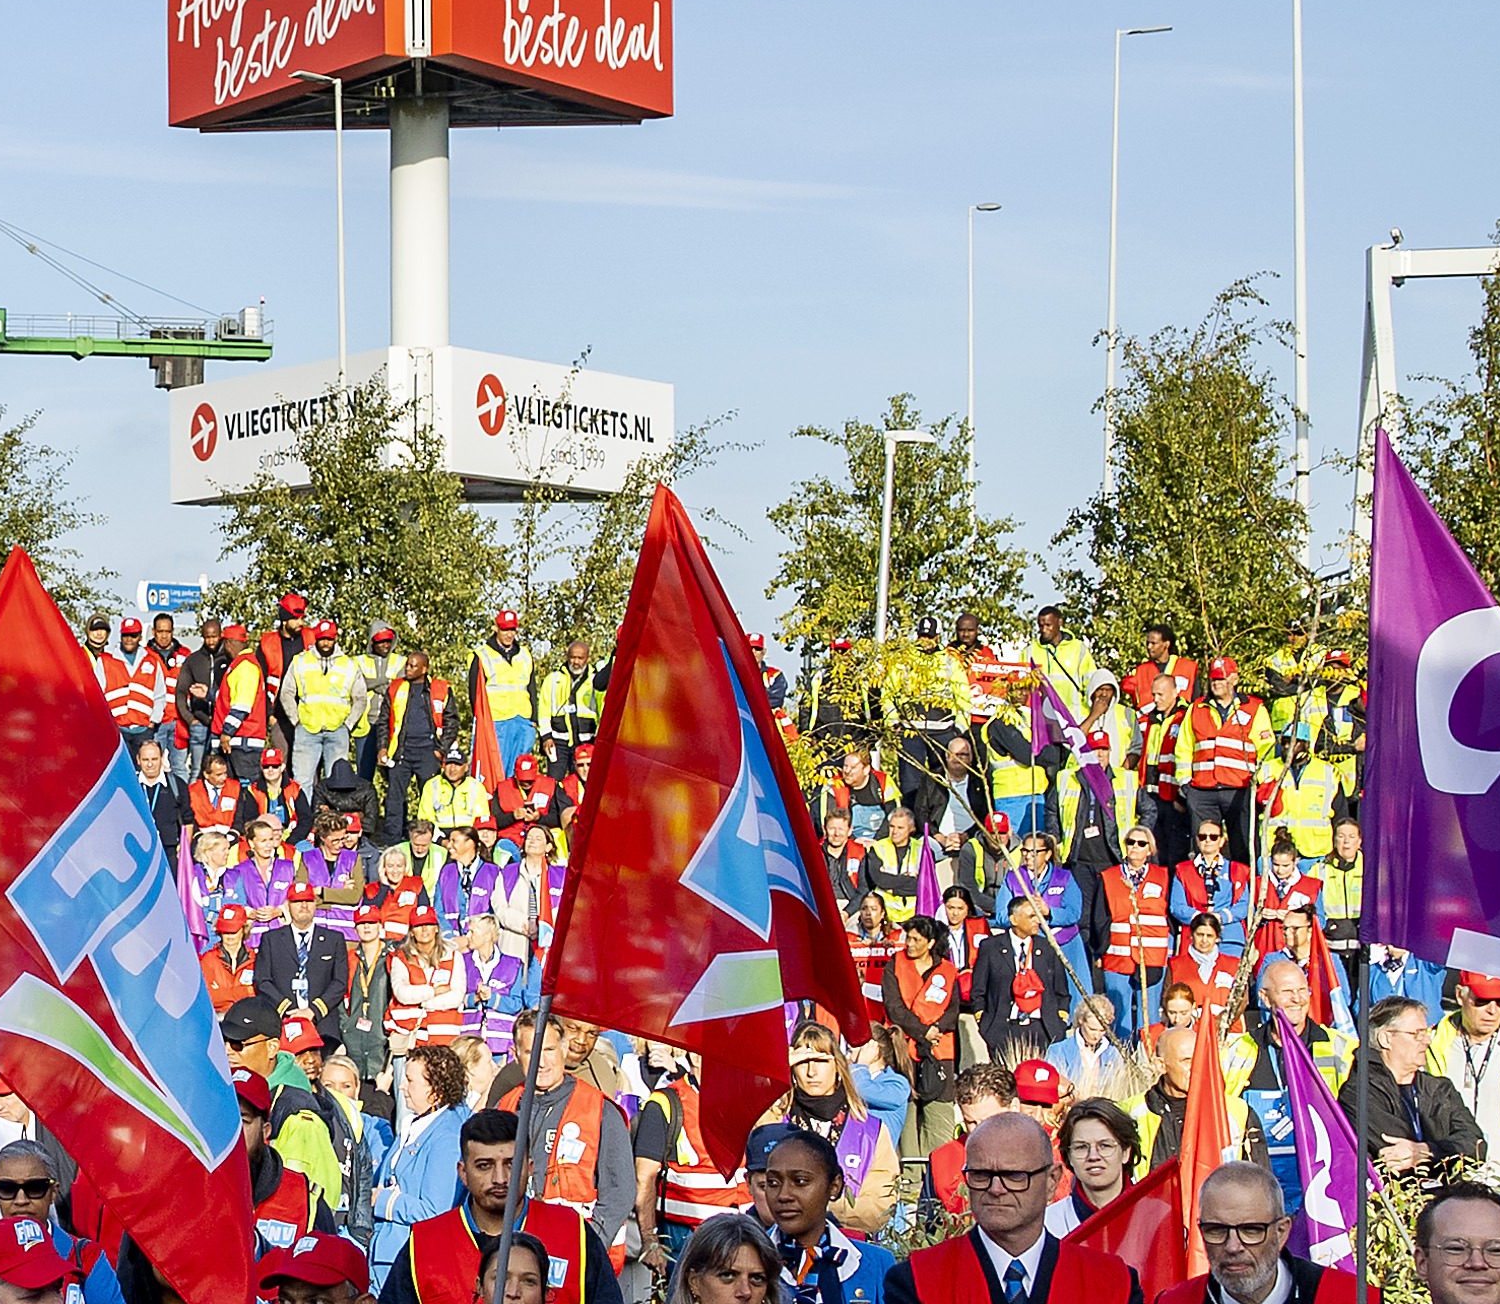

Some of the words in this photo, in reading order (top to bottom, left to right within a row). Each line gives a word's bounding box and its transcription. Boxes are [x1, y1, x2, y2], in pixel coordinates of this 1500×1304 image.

[215, 9, 301, 105] beste
[515, 395, 655, 444] VLIEGTICKETS.NL
[551, 444, 577, 465] sinds
[581, 447, 606, 469] 1999
[15, 1222, 43, 1243] FNV
